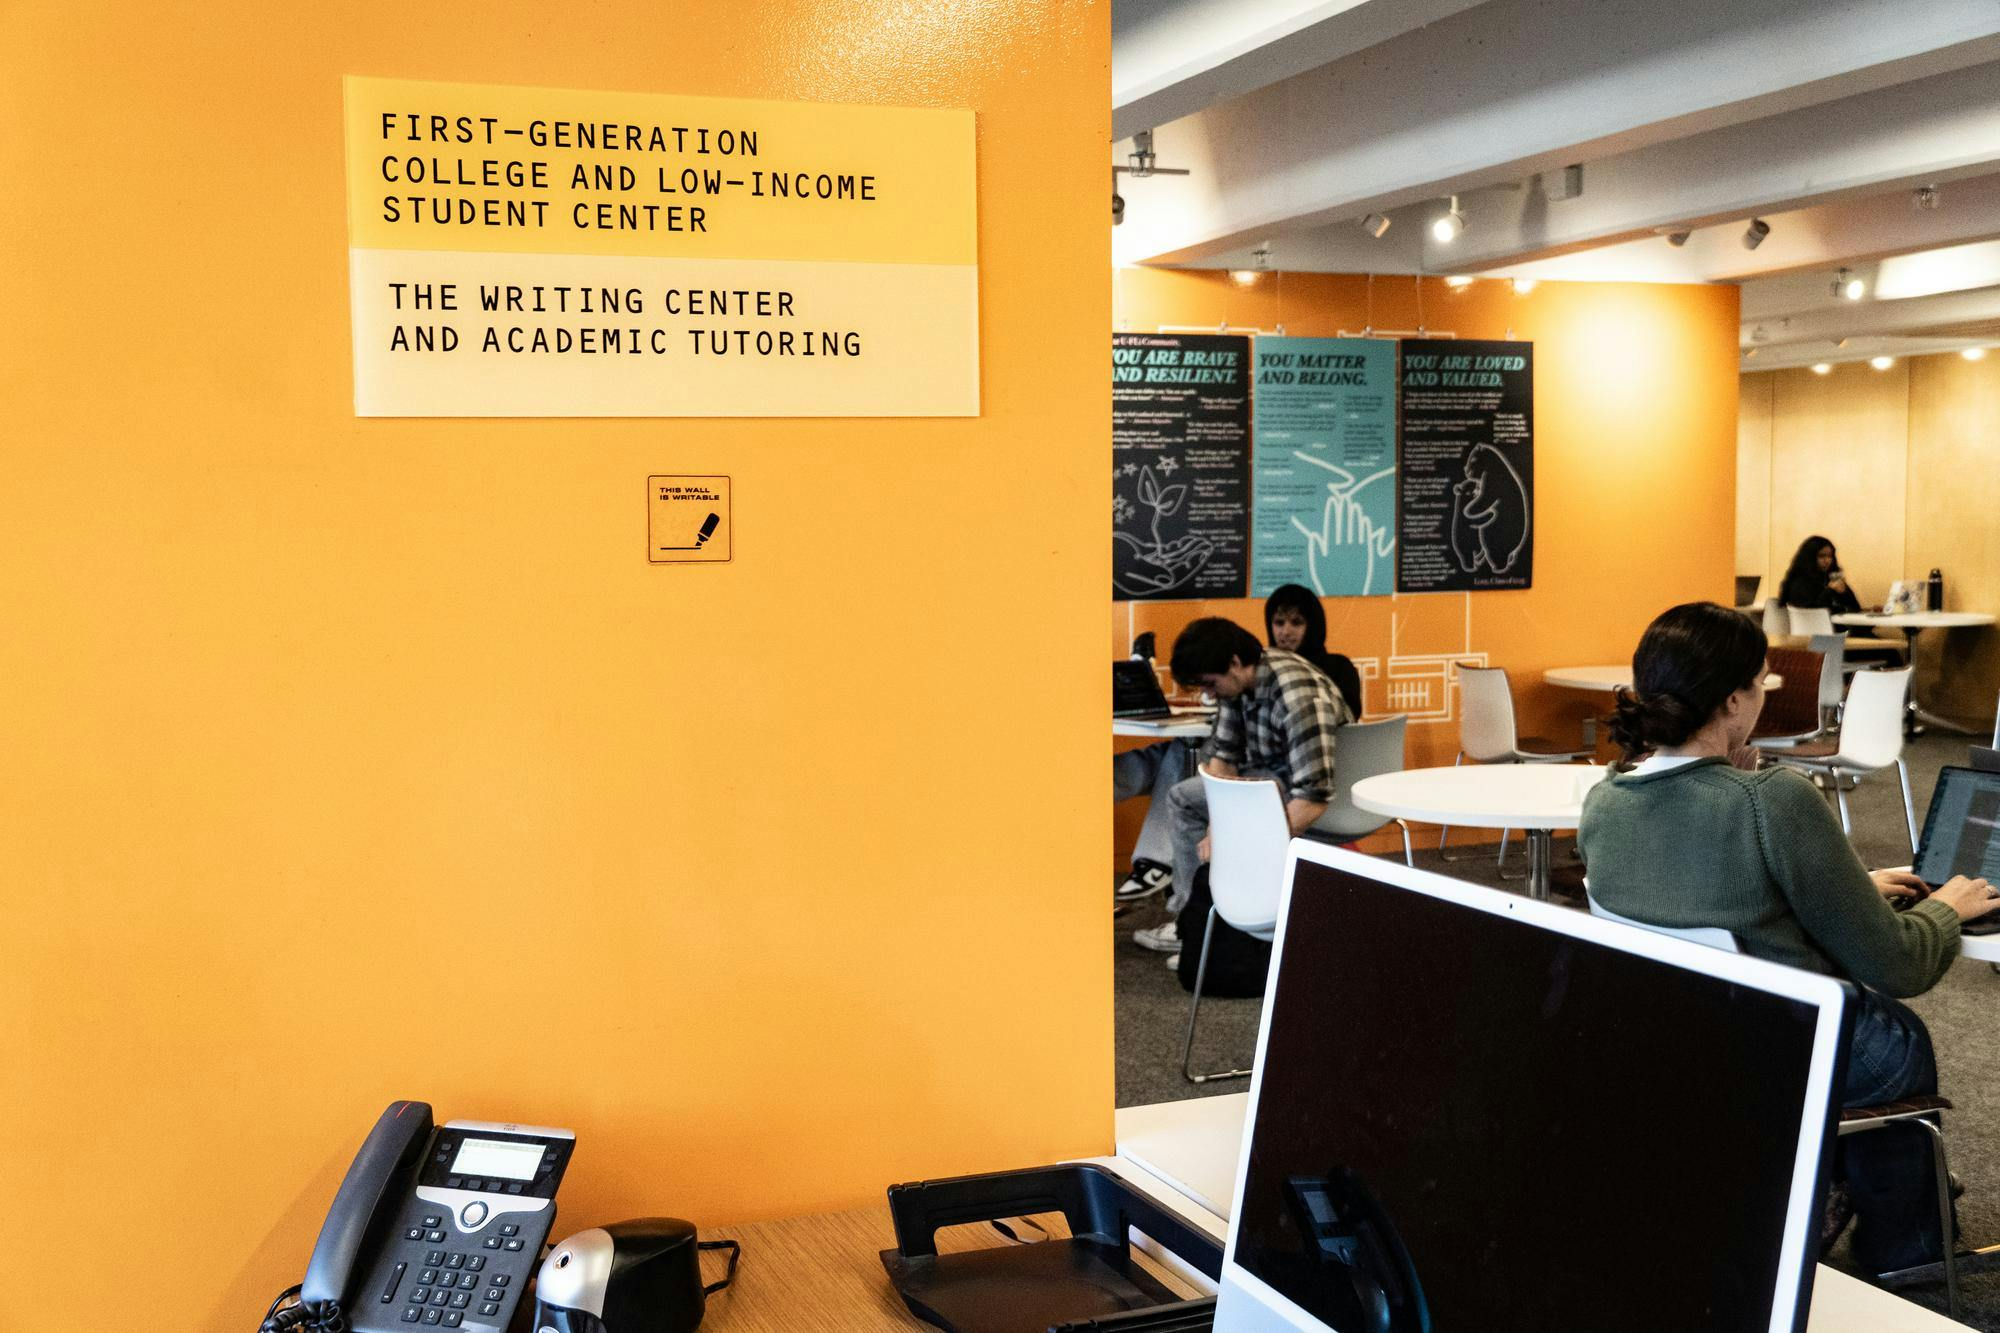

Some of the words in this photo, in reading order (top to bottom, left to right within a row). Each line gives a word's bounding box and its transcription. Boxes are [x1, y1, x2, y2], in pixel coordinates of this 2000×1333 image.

[382, 112, 759, 157] FIRST-GENERATION
[381, 155, 550, 189] COLLEGE
[570, 163, 637, 192] AND
[658, 167, 877, 201] LOW-INCOME
[382, 195, 550, 228] STUDENT
[572, 202, 707, 233] CENTER
[388, 283, 459, 311] THE
[480, 285, 643, 314] WRITING
[665, 289, 794, 317] CENTER
[390, 325, 460, 352] AND
[482, 326, 667, 355] ACADEMIC
[688, 329, 861, 357] TUTORING
[1112, 349, 1142, 365] OU
[1142, 349, 1180, 365] ARE
[1182, 350, 1239, 367] BRAVE
[1260, 353, 1295, 367] YOU
[1296, 354, 1366, 369] MATTER
[1404, 355, 1439, 370] YOU
[1439, 355, 1472, 370] ARE
[1474, 355, 1526, 371] LOVED
[1144, 367, 1238, 384] RESILIENT.
[1258, 370, 1295, 385] AND
[1297, 371, 1368, 386] BELONG.
[1402, 371, 1438, 386] AND
[1441, 371, 1504, 387] VALUED.
[433, 1252, 438, 1260] 1
[452, 1255, 459, 1263] 2
[472, 1257, 479, 1265] 3
[445, 1273, 451, 1281] 5
[465, 1275, 471, 1283] 6
[416, 1289, 423, 1297] 7
[436, 1292, 443, 1300] 8
[457, 1294, 464, 1302] 9
[428, 1310, 435, 1318] 0
